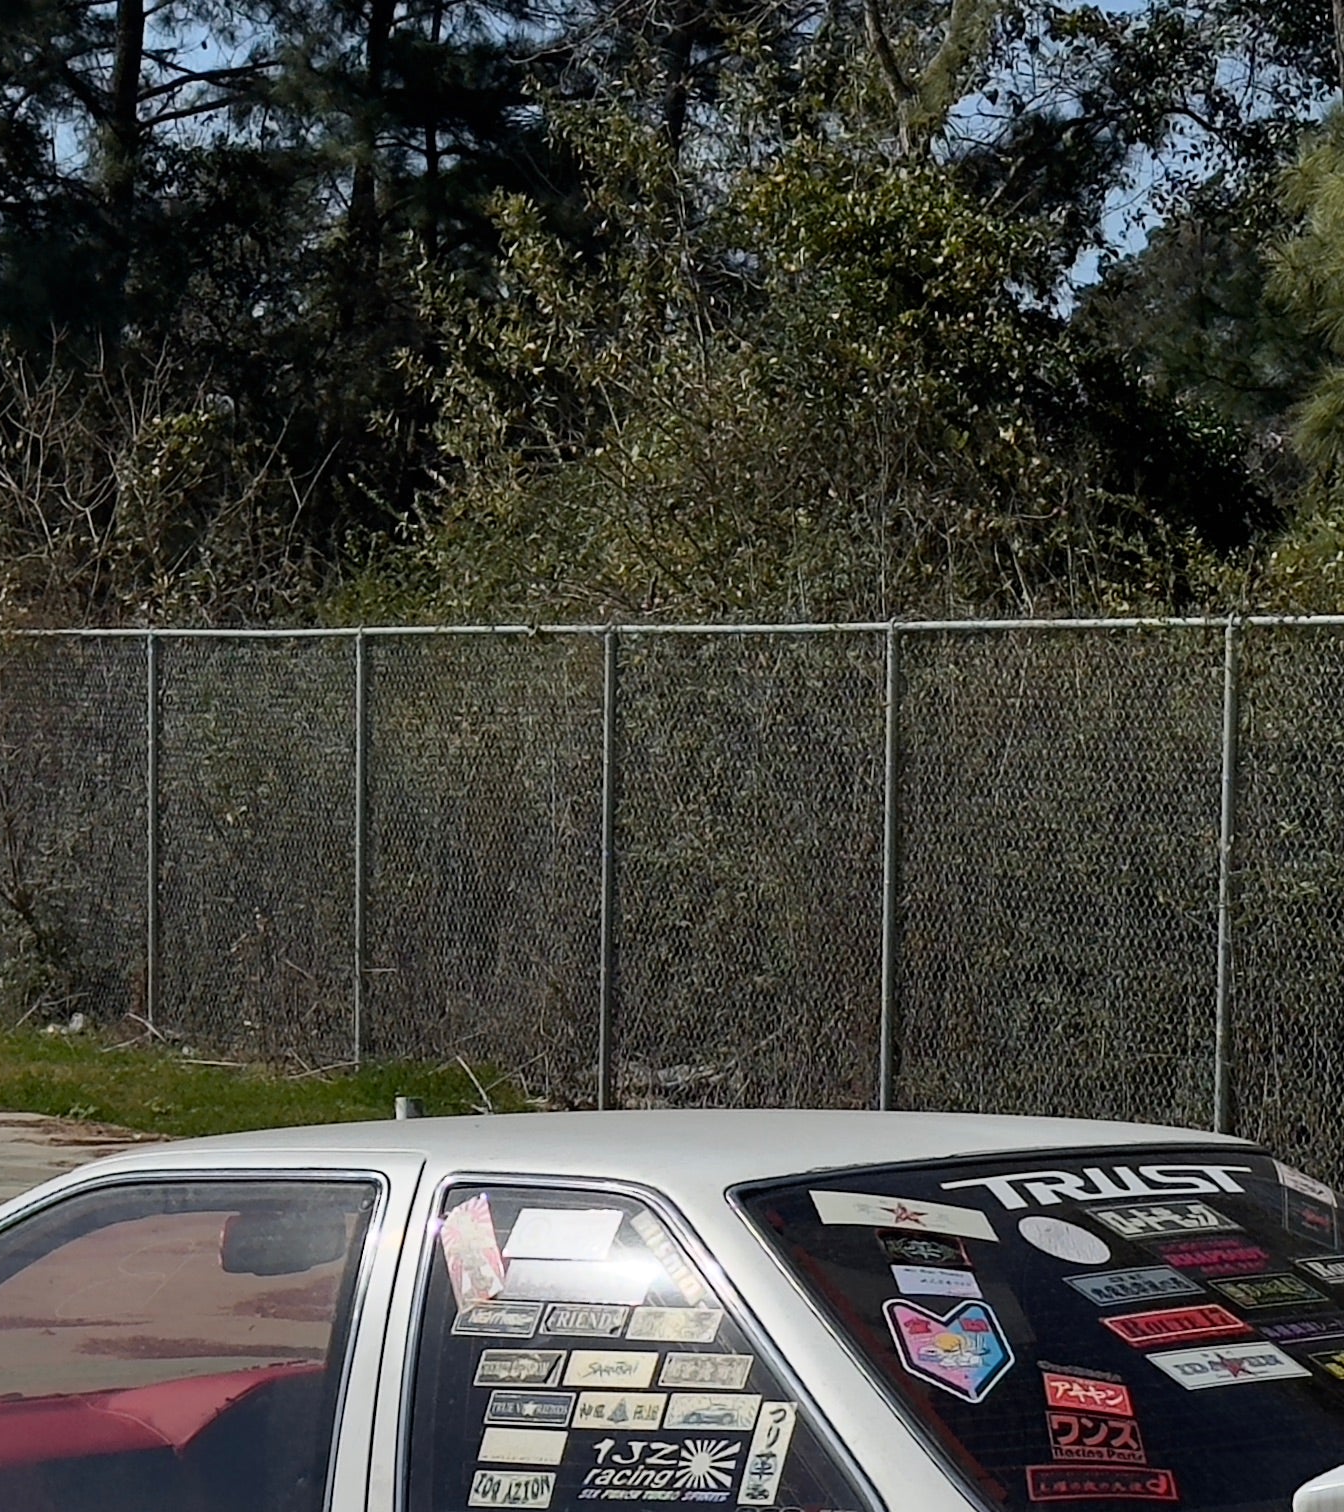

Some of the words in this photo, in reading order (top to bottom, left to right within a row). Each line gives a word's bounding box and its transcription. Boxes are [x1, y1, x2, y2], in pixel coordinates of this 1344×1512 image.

[941, 1165, 1252, 1210] TRUST
[592, 1438, 680, 1466] 1JZ
[583, 1464, 677, 1489] racing
